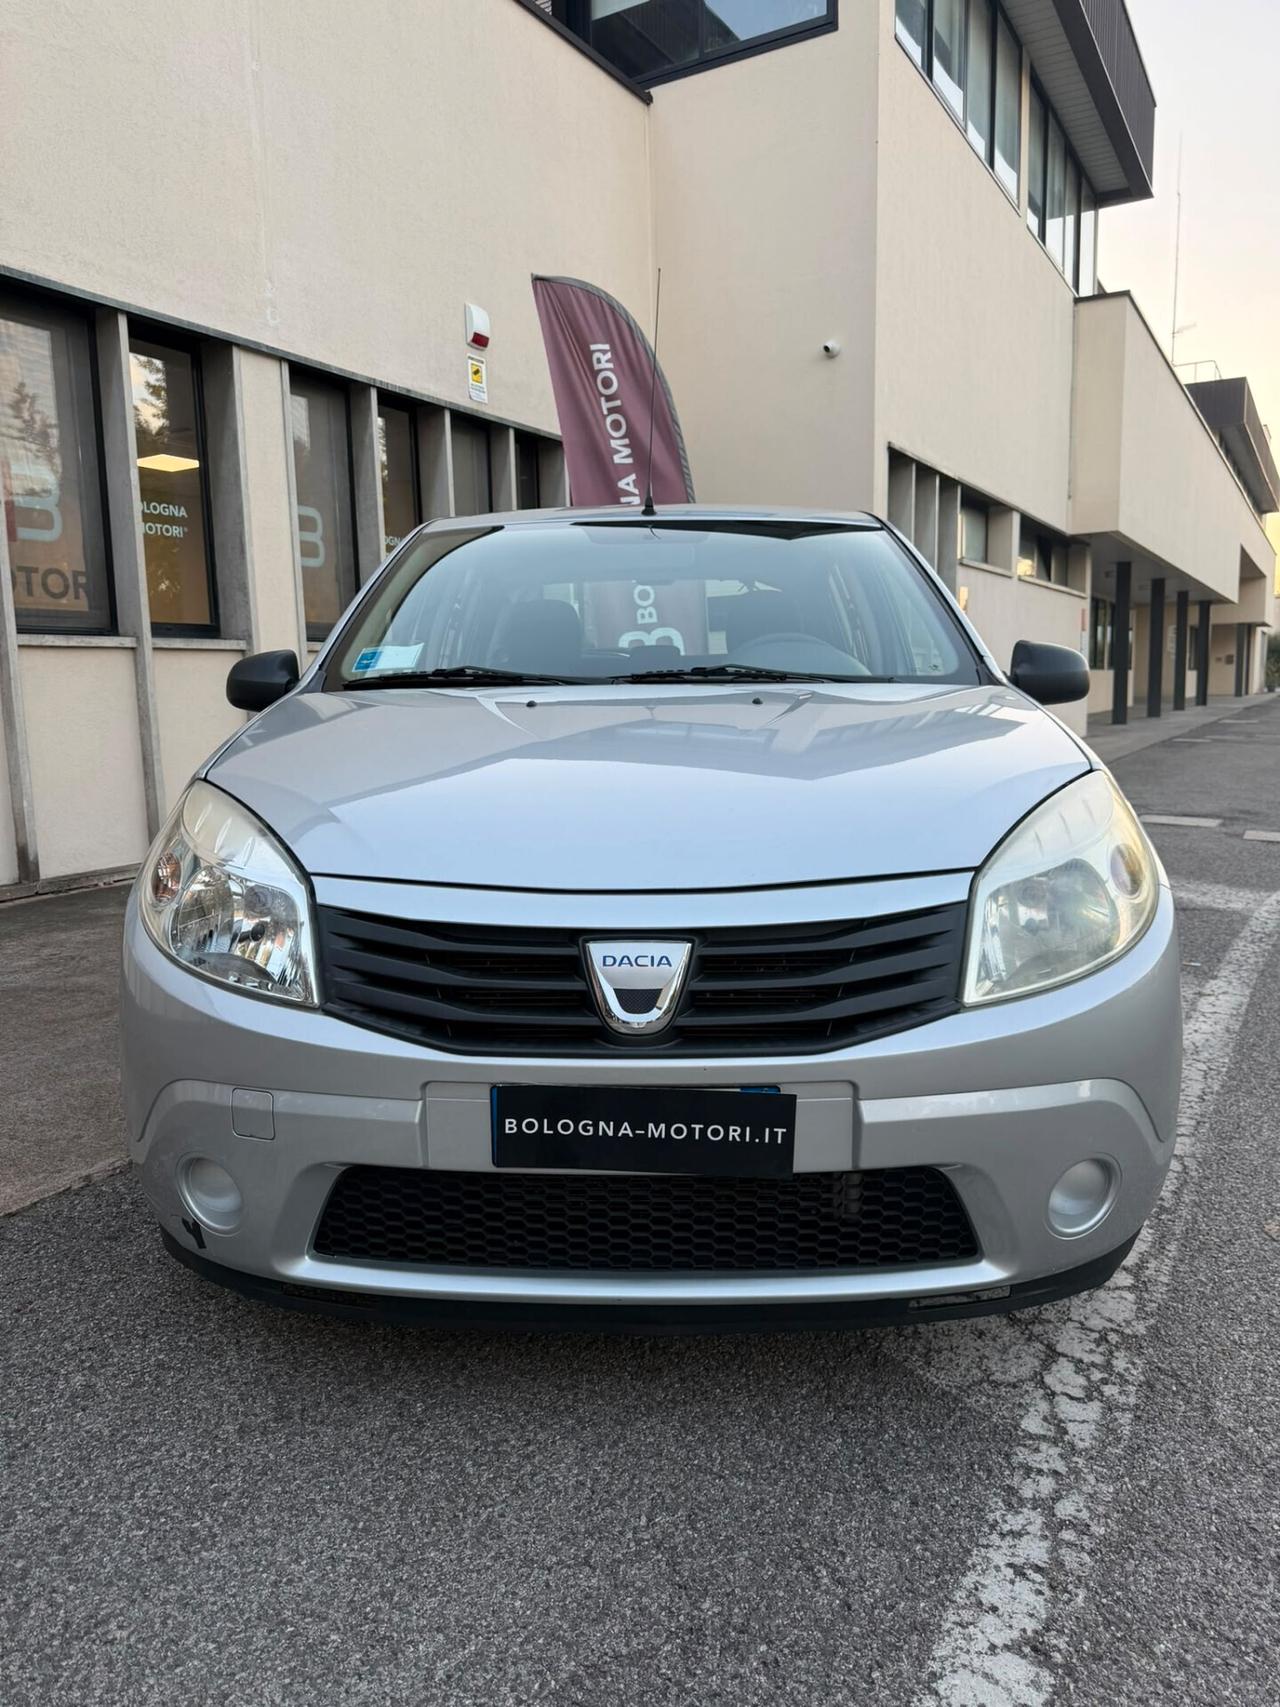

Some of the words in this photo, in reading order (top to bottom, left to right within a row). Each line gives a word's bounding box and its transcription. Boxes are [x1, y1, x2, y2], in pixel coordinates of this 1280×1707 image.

[590, 343, 634, 465] MOTORI
[602, 955, 672, 968] DACIA
[504, 1117, 788, 1145] BOLOGNA-MOTORI.IT
